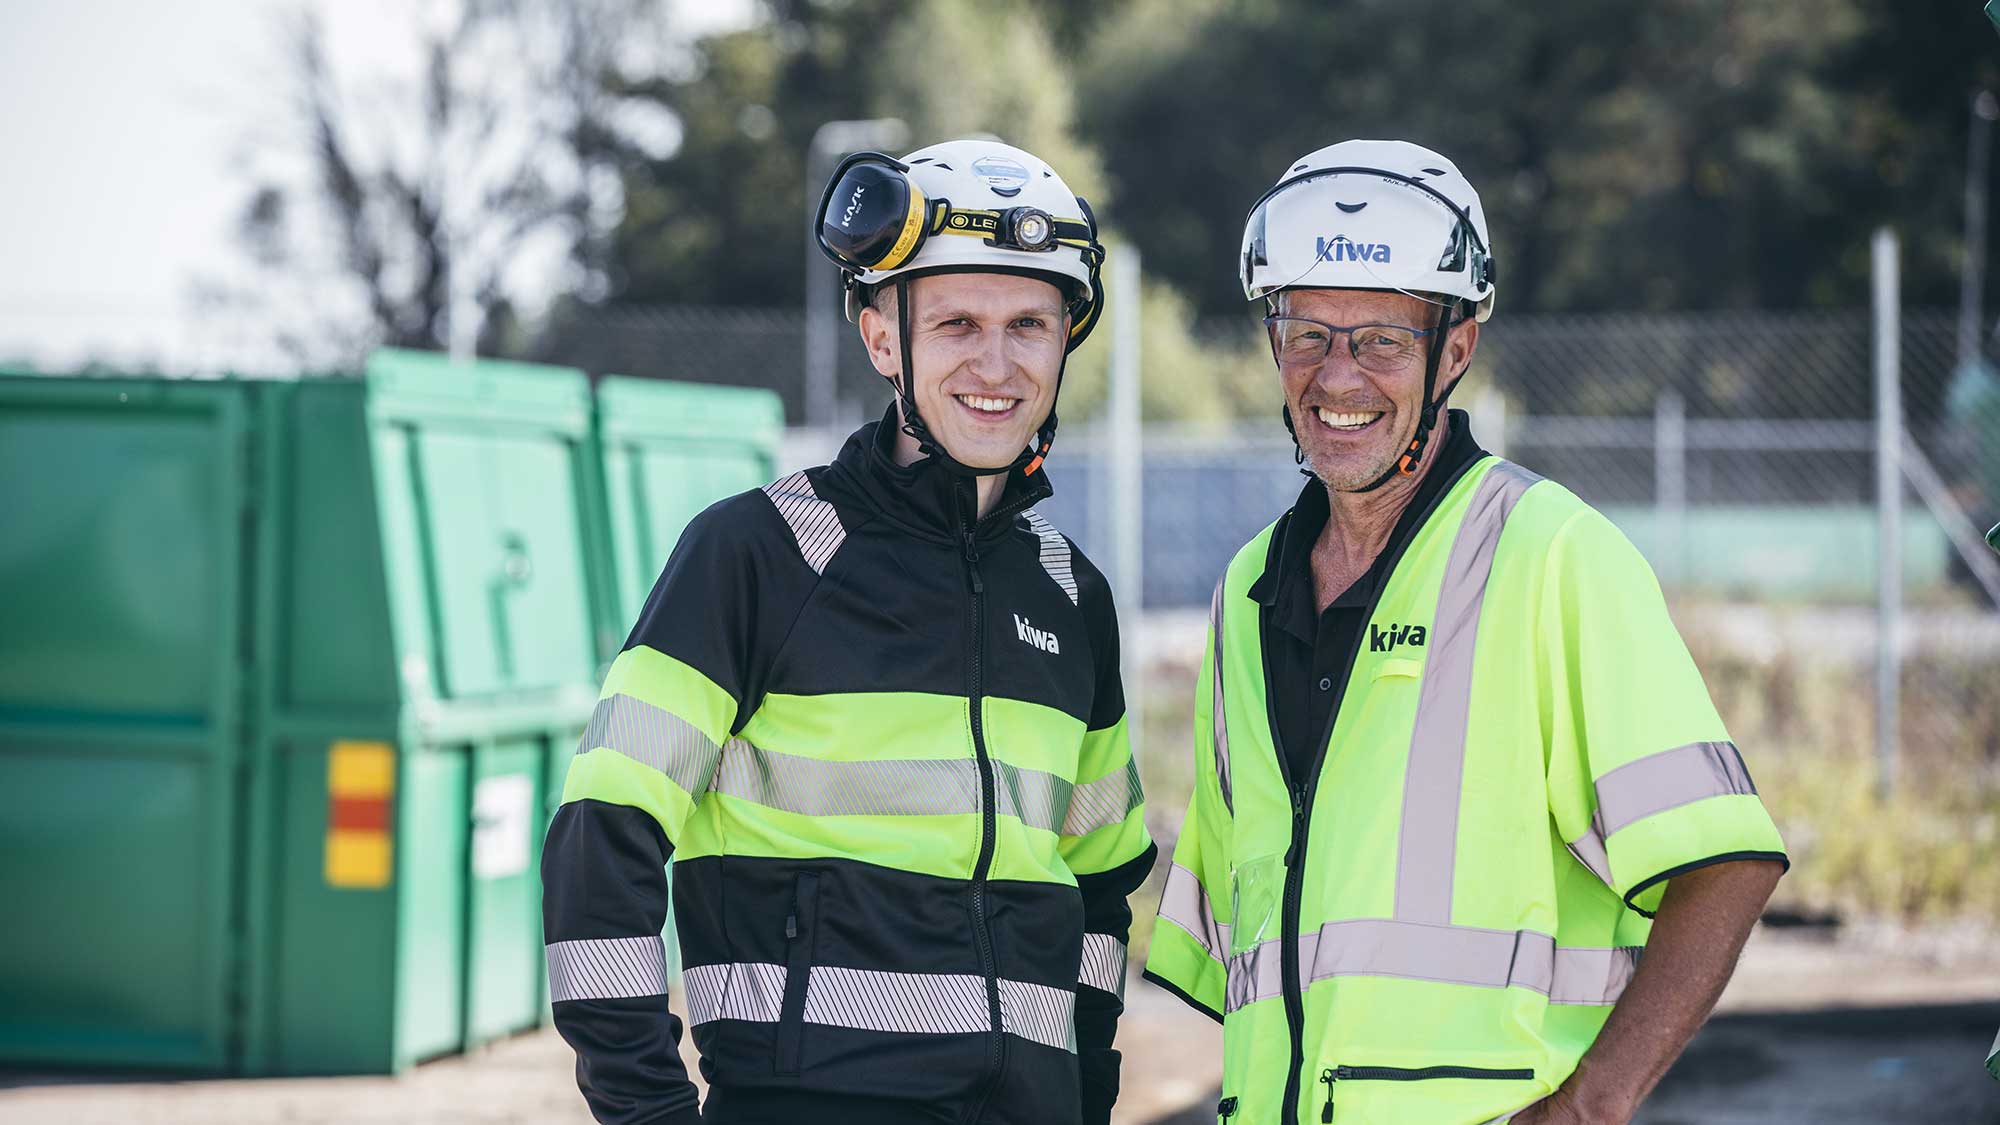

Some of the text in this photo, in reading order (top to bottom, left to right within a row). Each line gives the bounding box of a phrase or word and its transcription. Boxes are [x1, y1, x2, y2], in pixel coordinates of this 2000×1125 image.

[841, 185, 865, 227] KASK
[972, 217, 997, 230] LE
[1316, 234, 1391, 263] kiwa
[1013, 613, 1060, 655] kiwa
